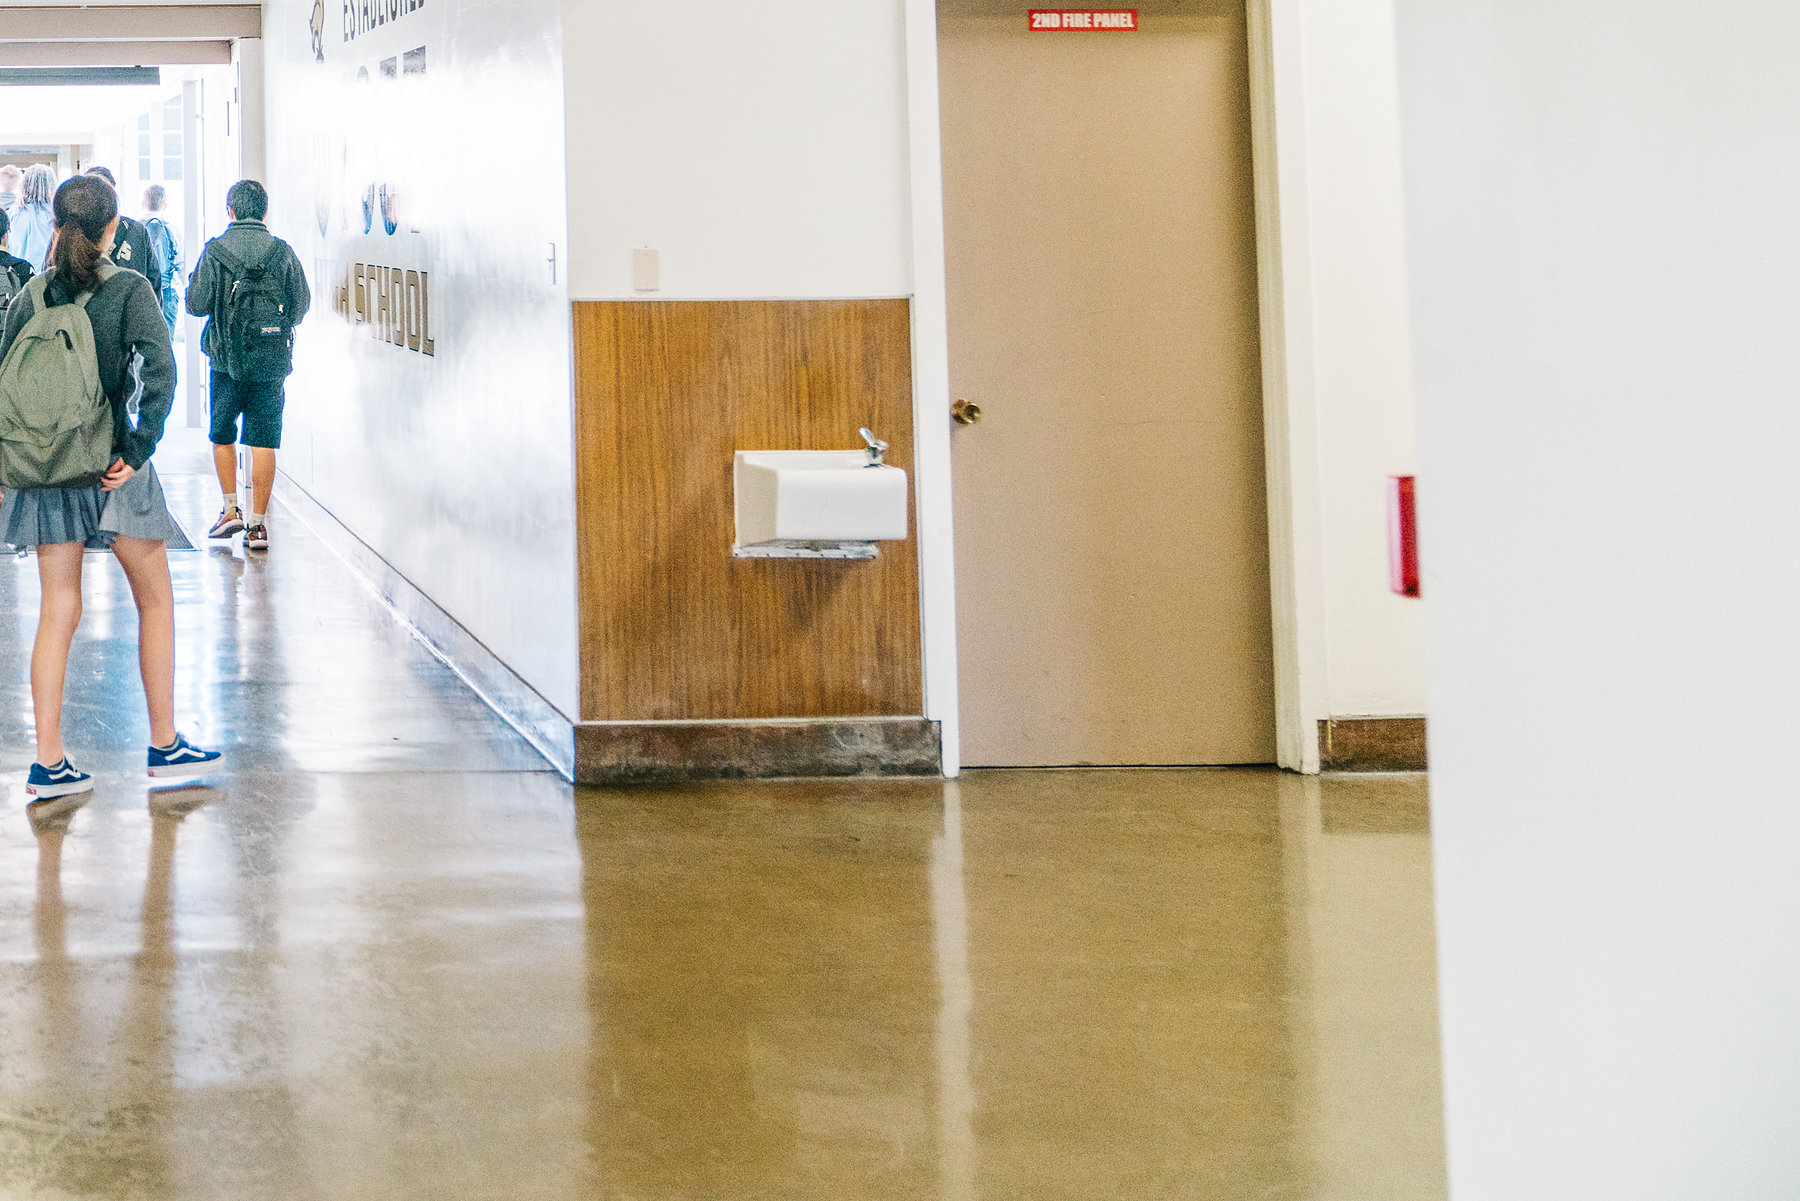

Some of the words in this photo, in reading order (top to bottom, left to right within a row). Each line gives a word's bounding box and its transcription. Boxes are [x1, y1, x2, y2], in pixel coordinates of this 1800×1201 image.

[1031, 12, 1061, 28] 2ND
[1062, 12, 1092, 28] FIRE
[1093, 12, 1135, 28] PANEL
[353, 262, 435, 358] SCHOOL
